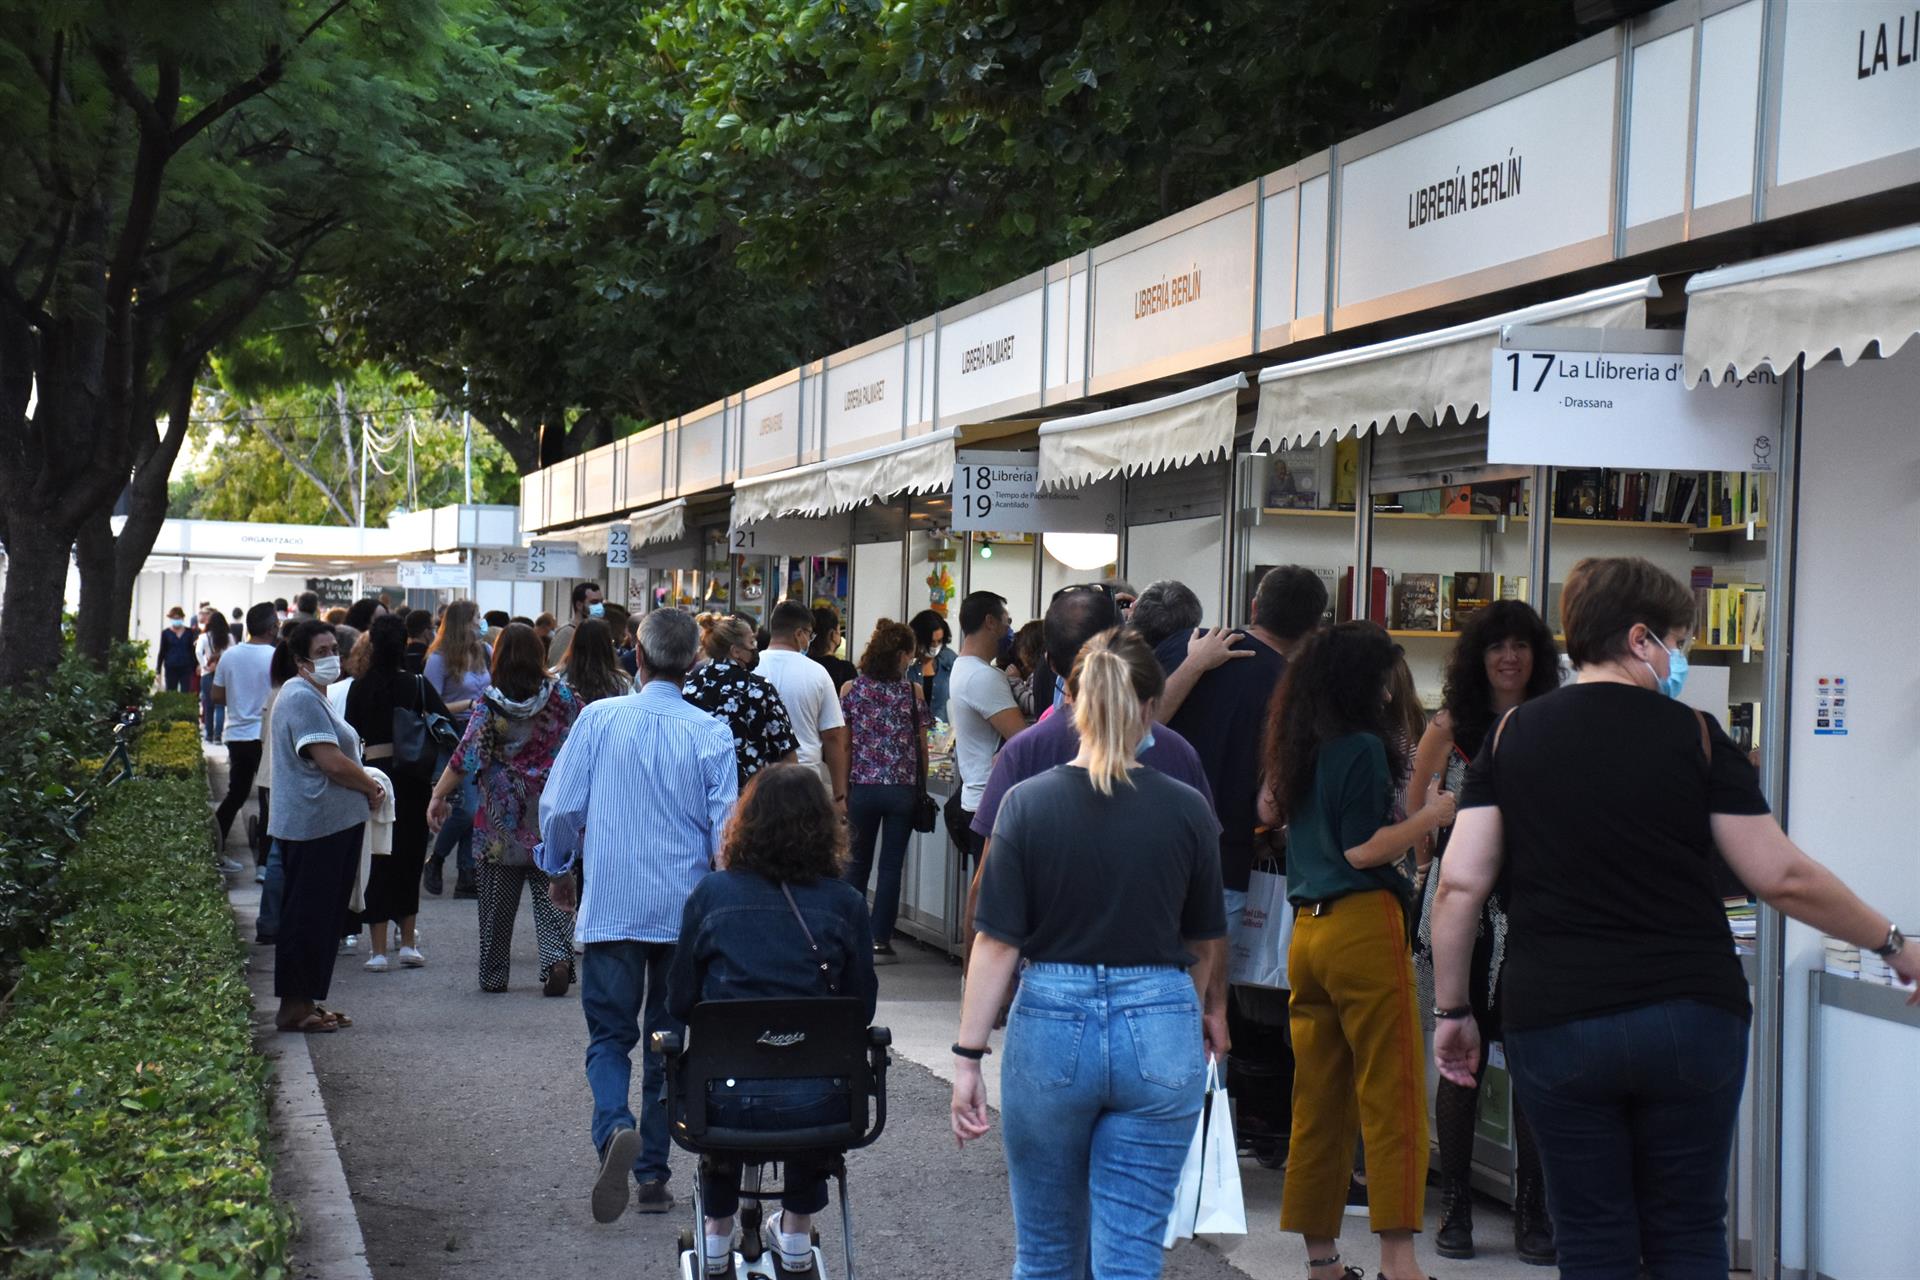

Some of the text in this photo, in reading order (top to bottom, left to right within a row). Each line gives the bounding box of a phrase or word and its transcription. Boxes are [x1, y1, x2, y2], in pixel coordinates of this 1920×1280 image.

[1858, 22, 1888, 80] LA
[1408, 146, 1522, 230] LIBRERÍA BERLÍN
[1134, 262, 1201, 320] LIBRERÍA BERLÍN
[986, 335, 1015, 367] PALMARET
[1506, 352, 1556, 393] 17
[1559, 360, 1579, 379] La
[1585, 358, 1660, 381] Llibreria
[1564, 397, 1613, 409] Drassana
[962, 466, 991, 490] 18
[992, 470, 1032, 482] Librería
[996, 491, 1019, 500] Tiempo
[1020, 491, 1029, 499] de
[1030, 492, 1047, 501] Papel
[962, 494, 991, 518] 19
[995, 501, 1029, 509] Acantilado
[610, 531, 628, 545] 22
[735, 530, 755, 548] 21
[501, 552, 515, 563] 26
[531, 546, 546, 558] 24
[610, 550, 628, 563] 23
[479, 555, 492, 566] 27
[530, 561, 545, 573] 25
